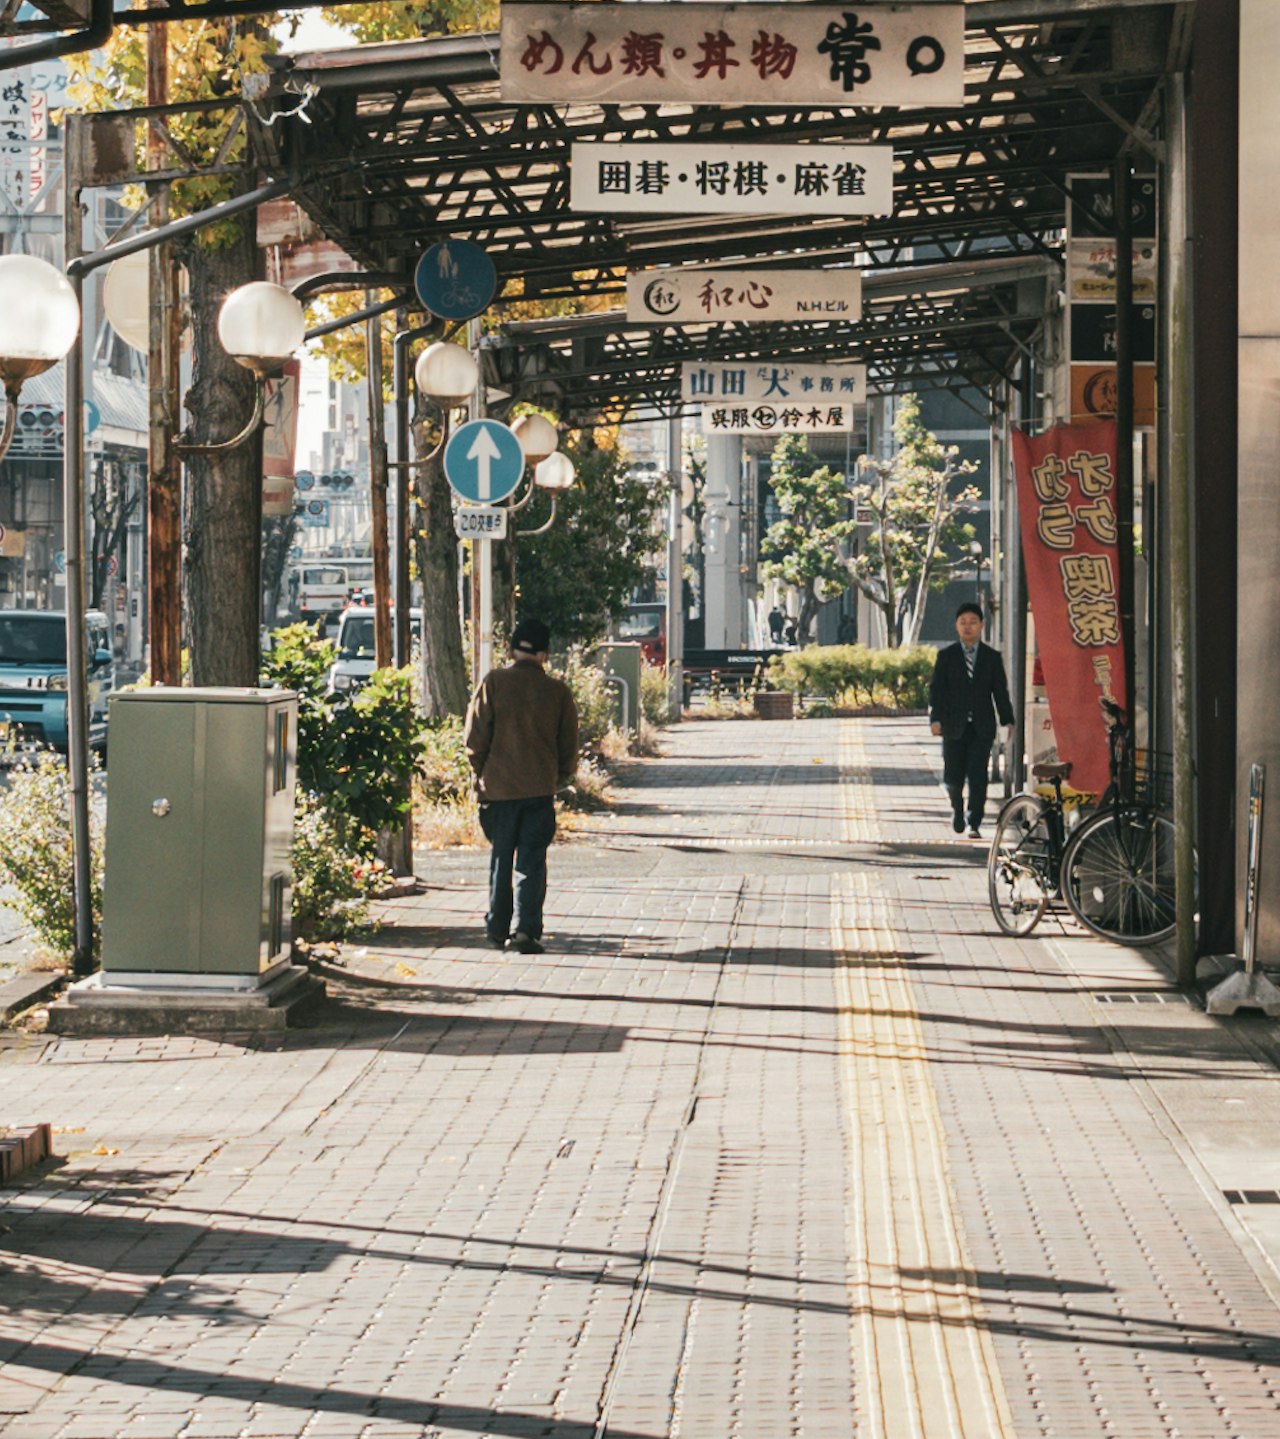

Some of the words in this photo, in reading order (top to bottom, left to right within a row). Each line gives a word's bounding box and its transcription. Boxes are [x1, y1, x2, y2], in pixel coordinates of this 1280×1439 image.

[598, 159, 867, 197] 囲碁・将棋・麻雀
